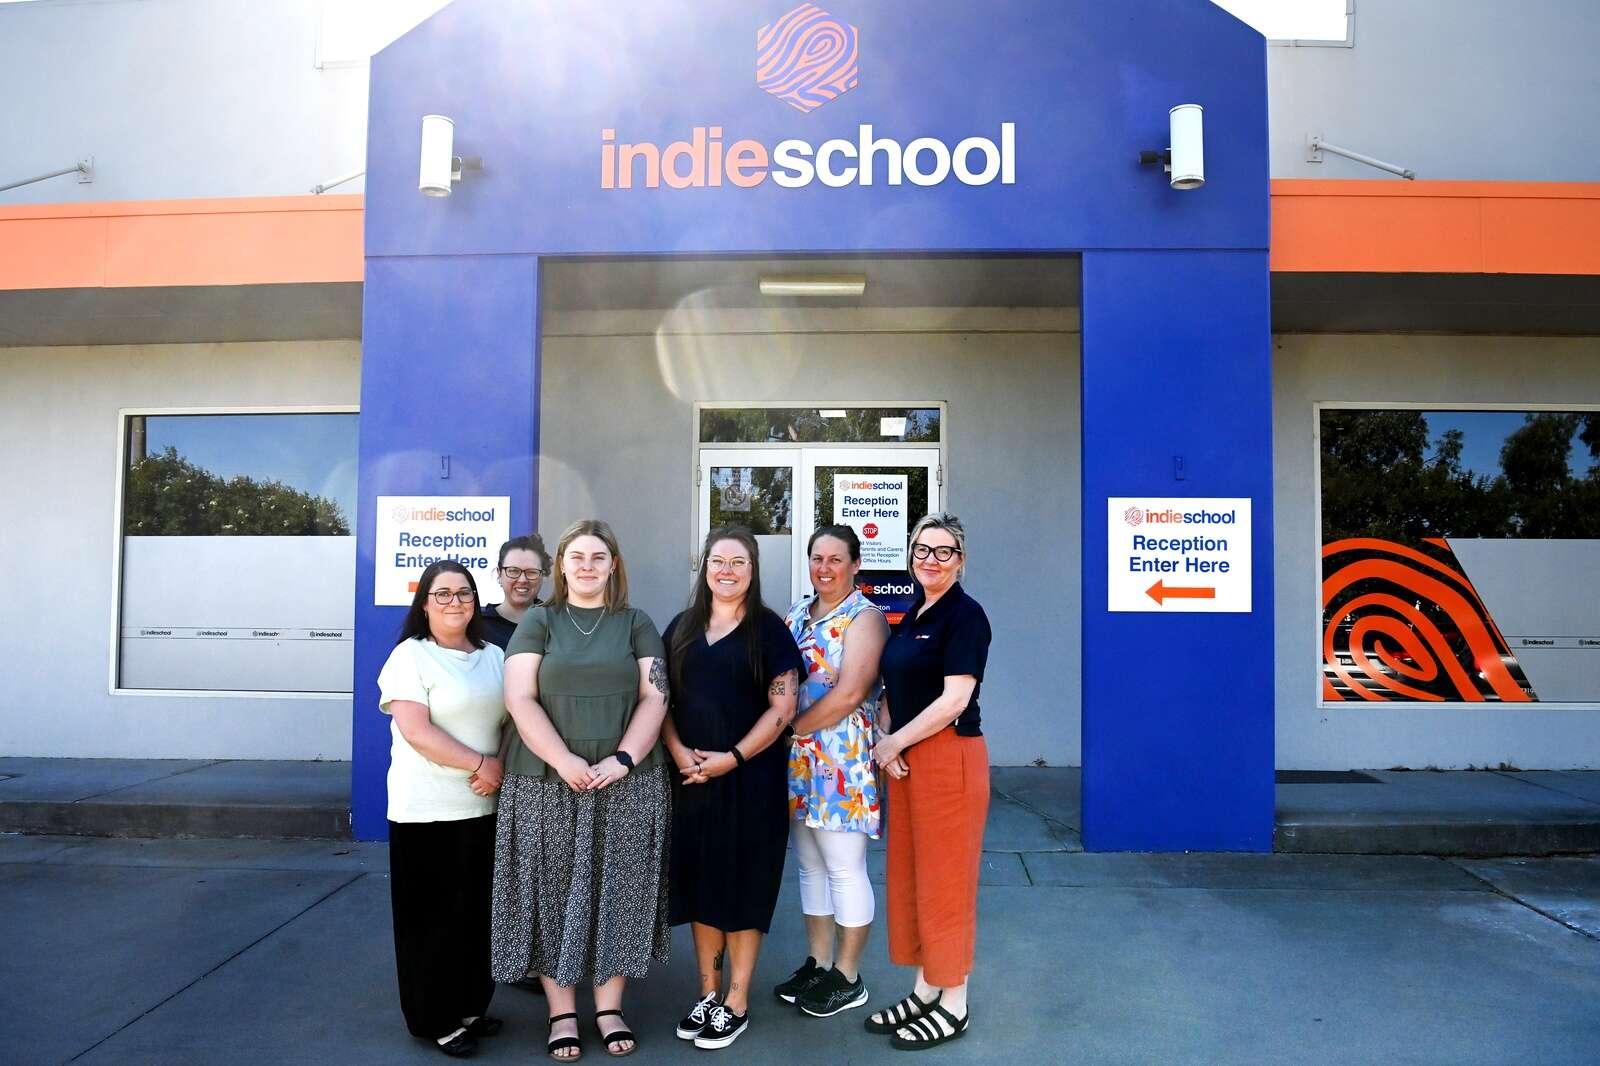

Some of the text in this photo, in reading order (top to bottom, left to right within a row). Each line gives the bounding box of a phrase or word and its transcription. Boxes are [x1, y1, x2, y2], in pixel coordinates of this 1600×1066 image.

[601, 122, 1016, 189] indieschool
[851, 481, 903, 490] indieschool
[844, 496, 898, 510] Reception
[411, 508, 495, 522] indieschool
[842, 508, 899, 518] Enter Here
[1145, 509, 1236, 524] indieschool
[863, 527, 878, 535] STOP
[399, 532, 487, 551] Reception
[1133, 535, 1228, 554] Reception
[1129, 557, 1230, 573] Enter Here
